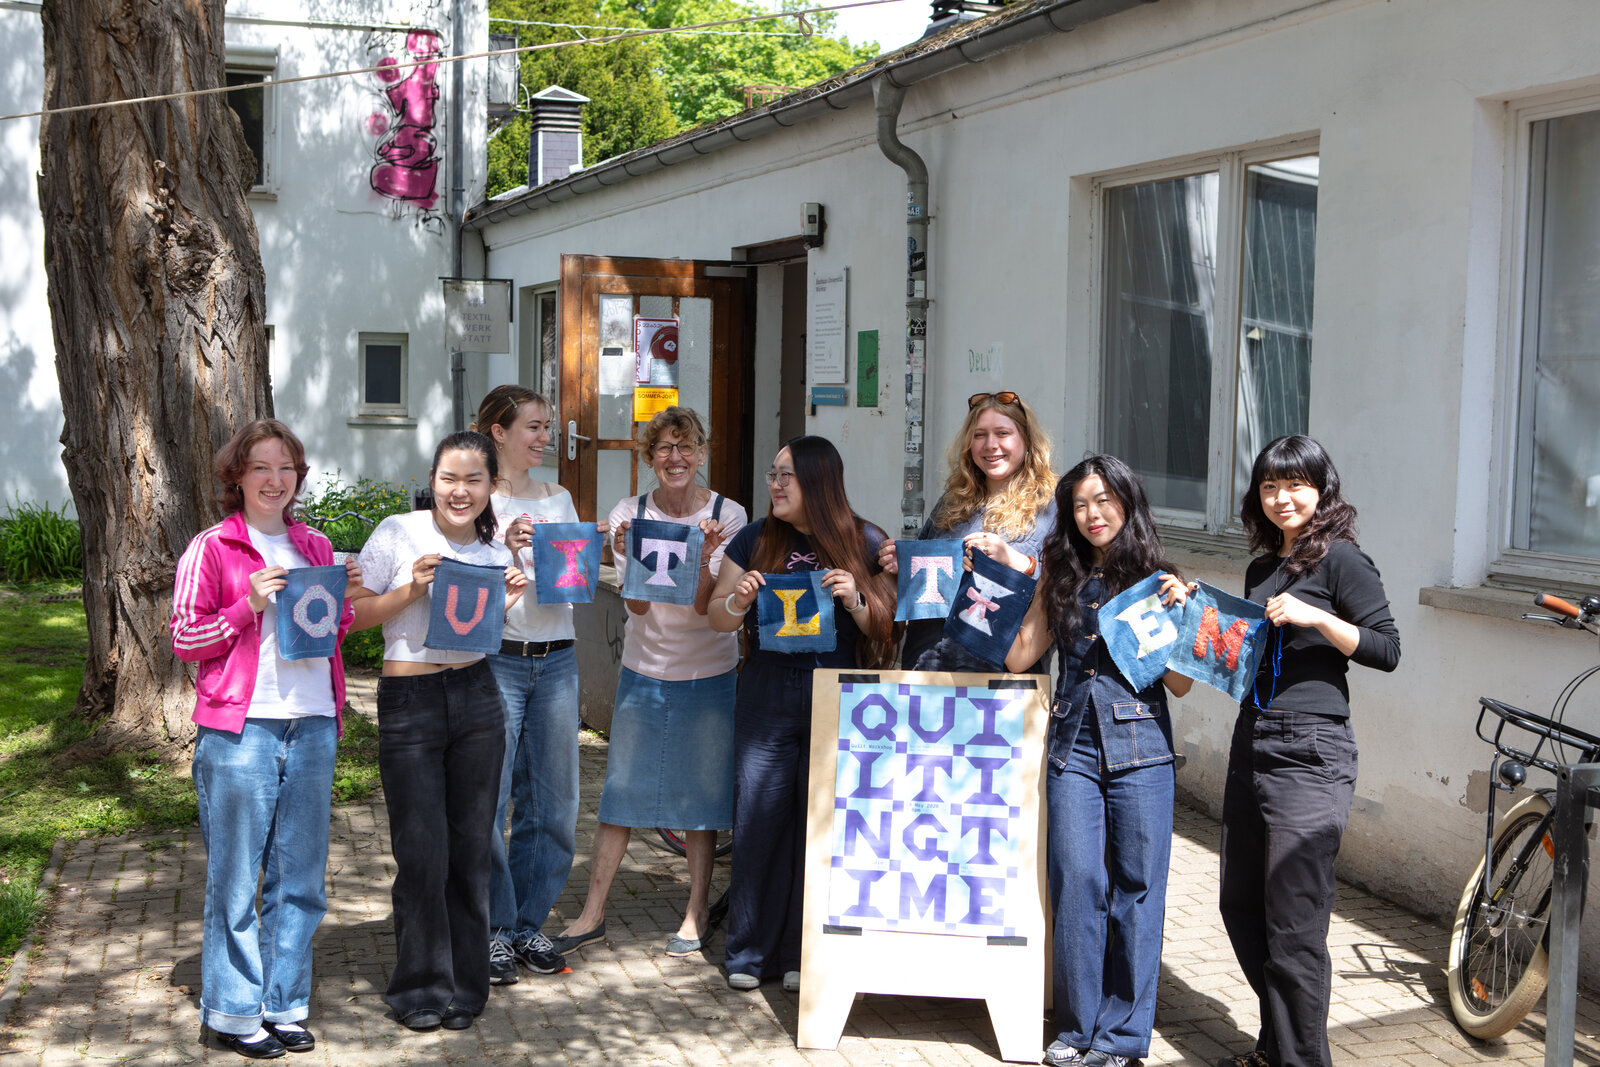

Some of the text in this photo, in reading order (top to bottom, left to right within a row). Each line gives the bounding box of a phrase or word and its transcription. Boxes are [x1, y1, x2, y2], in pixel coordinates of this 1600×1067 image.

[462, 312, 492, 321] TEXTIL
[462, 323, 492, 332] WERK
[462, 334, 492, 343] STATT
[550, 540, 590, 588] I
[640, 538, 687, 587] T
[910, 556, 953, 604] T
[293, 584, 338, 638] Q
[444, 585, 489, 635] U
[773, 589, 821, 637] L
[1114, 593, 1178, 660] E
[1193, 605, 1250, 671] M
